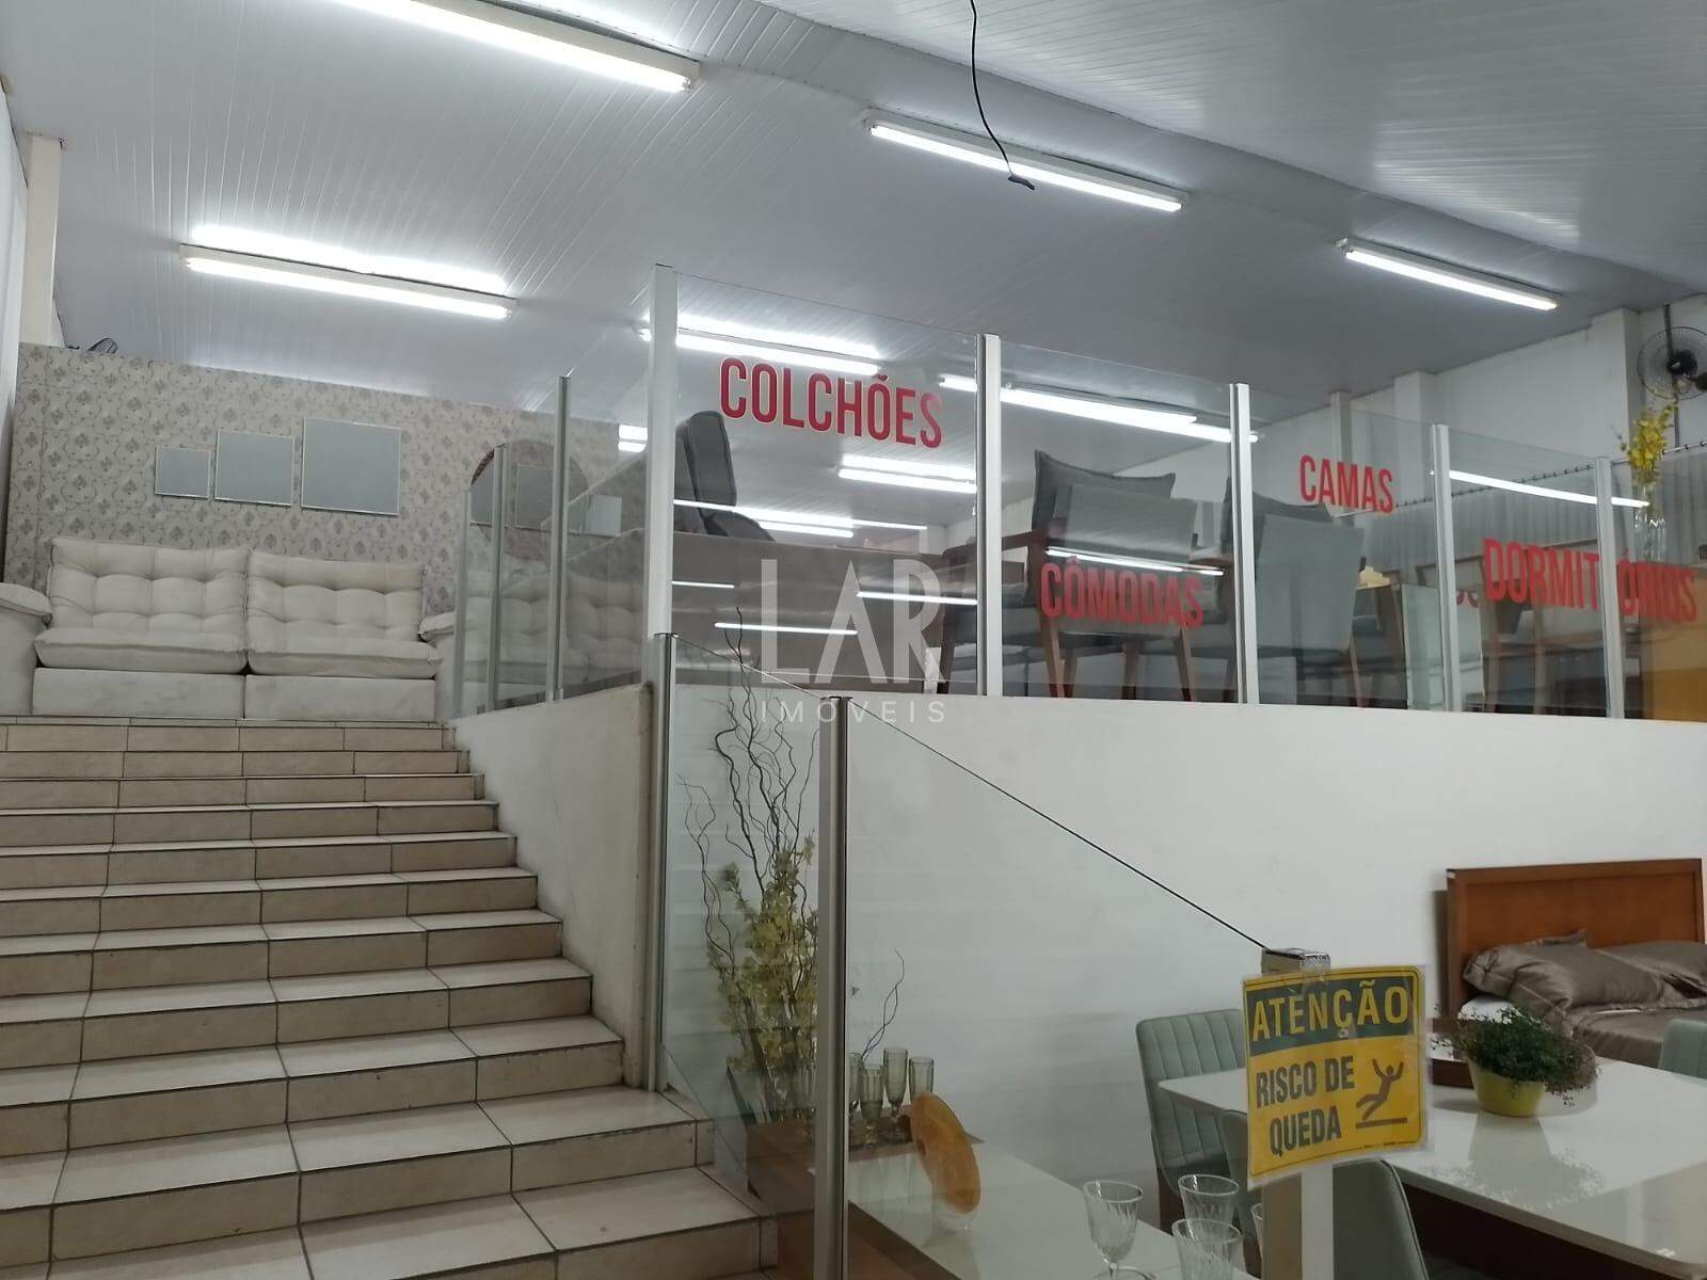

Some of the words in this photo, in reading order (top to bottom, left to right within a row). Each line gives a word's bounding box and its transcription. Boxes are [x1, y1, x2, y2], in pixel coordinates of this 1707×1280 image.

[720, 358, 942, 448] COLCHÕES
[1300, 455, 1394, 514] CAMAS
[1040, 556, 1204, 629] CÔMODAS
[1252, 980, 1408, 1042] ATENÇÃO
[1256, 1060, 1317, 1107] RISCO
[1325, 1056, 1355, 1092] DE
[1269, 1105, 1342, 1157] QUEDA
